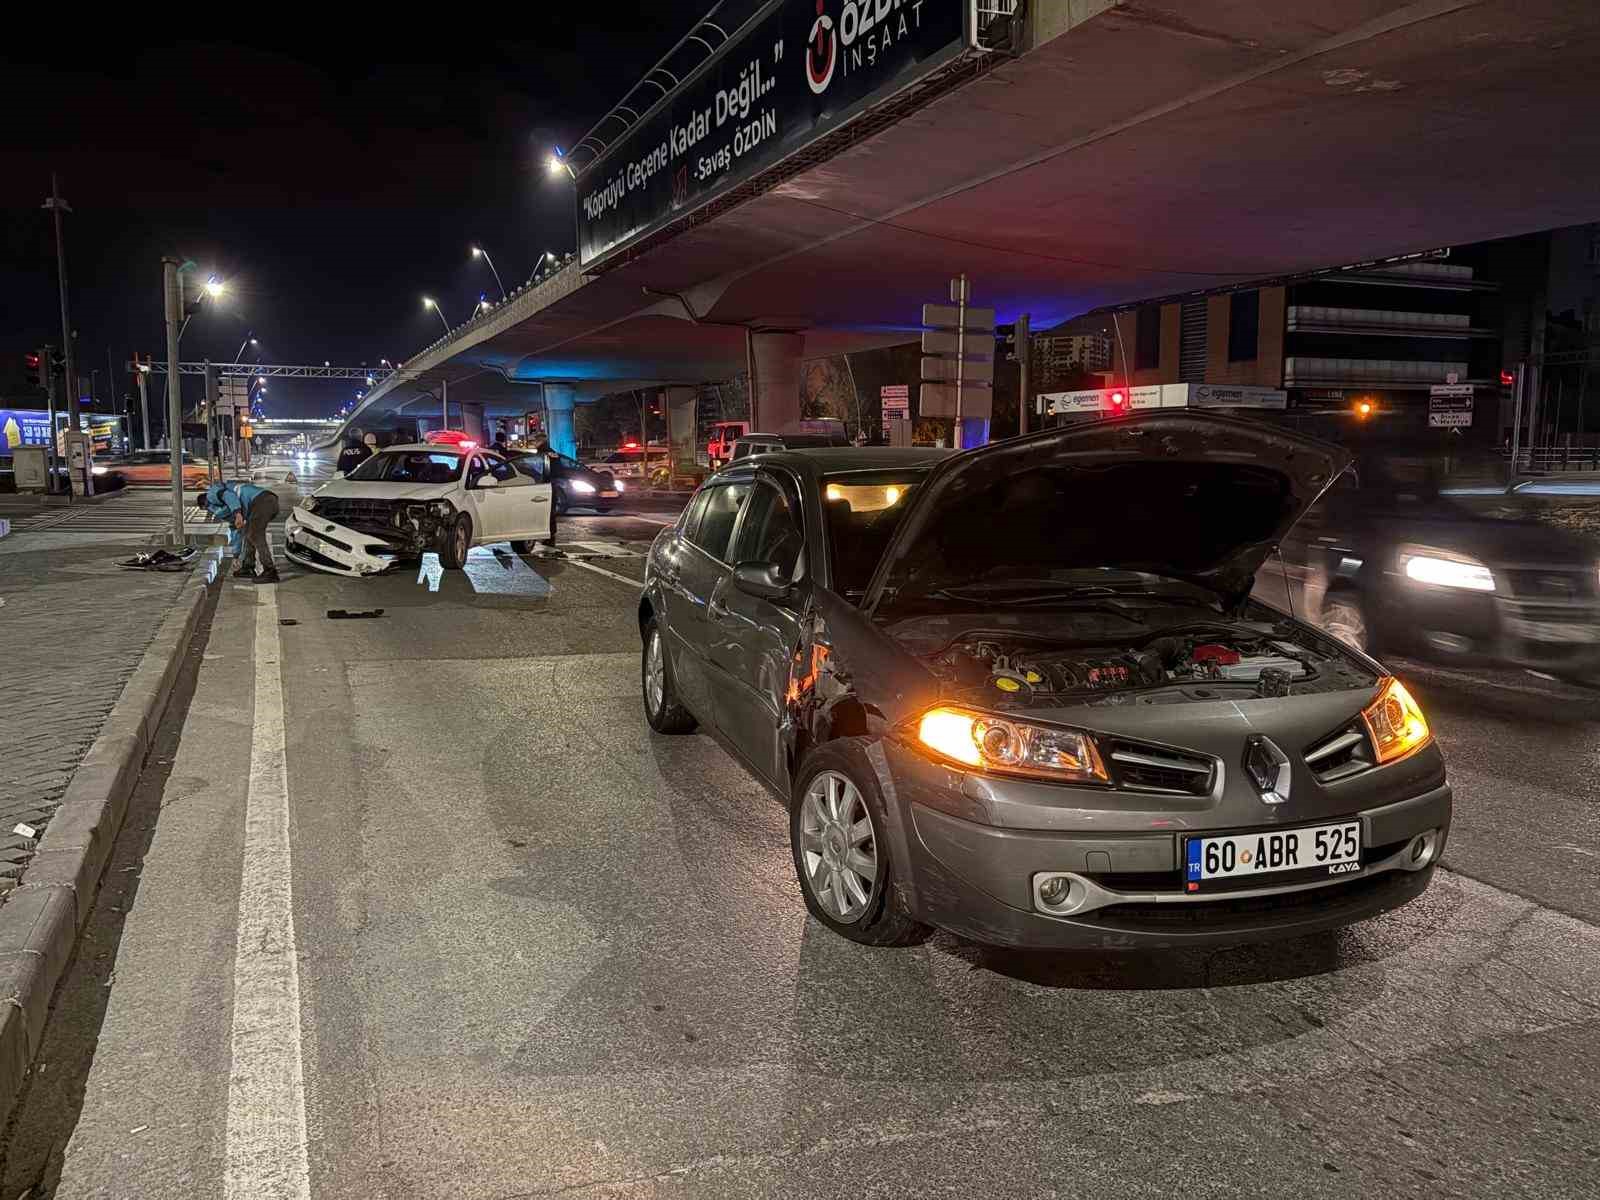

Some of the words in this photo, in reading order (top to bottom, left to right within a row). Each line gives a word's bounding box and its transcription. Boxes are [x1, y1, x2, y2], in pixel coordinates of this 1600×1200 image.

[842, 1, 923, 77] İNŞAAT
[626, 142, 668, 190] Geçene
[669, 107, 711, 161] Kadar
[734, 107, 776, 157] ÖZDİN
[1188, 863, 1201, 873] TR
[1205, 841, 1236, 874] 60
[1254, 834, 1299, 870] ABR
[1315, 826, 1357, 862] 525
[1328, 862, 1361, 874] KAYA
